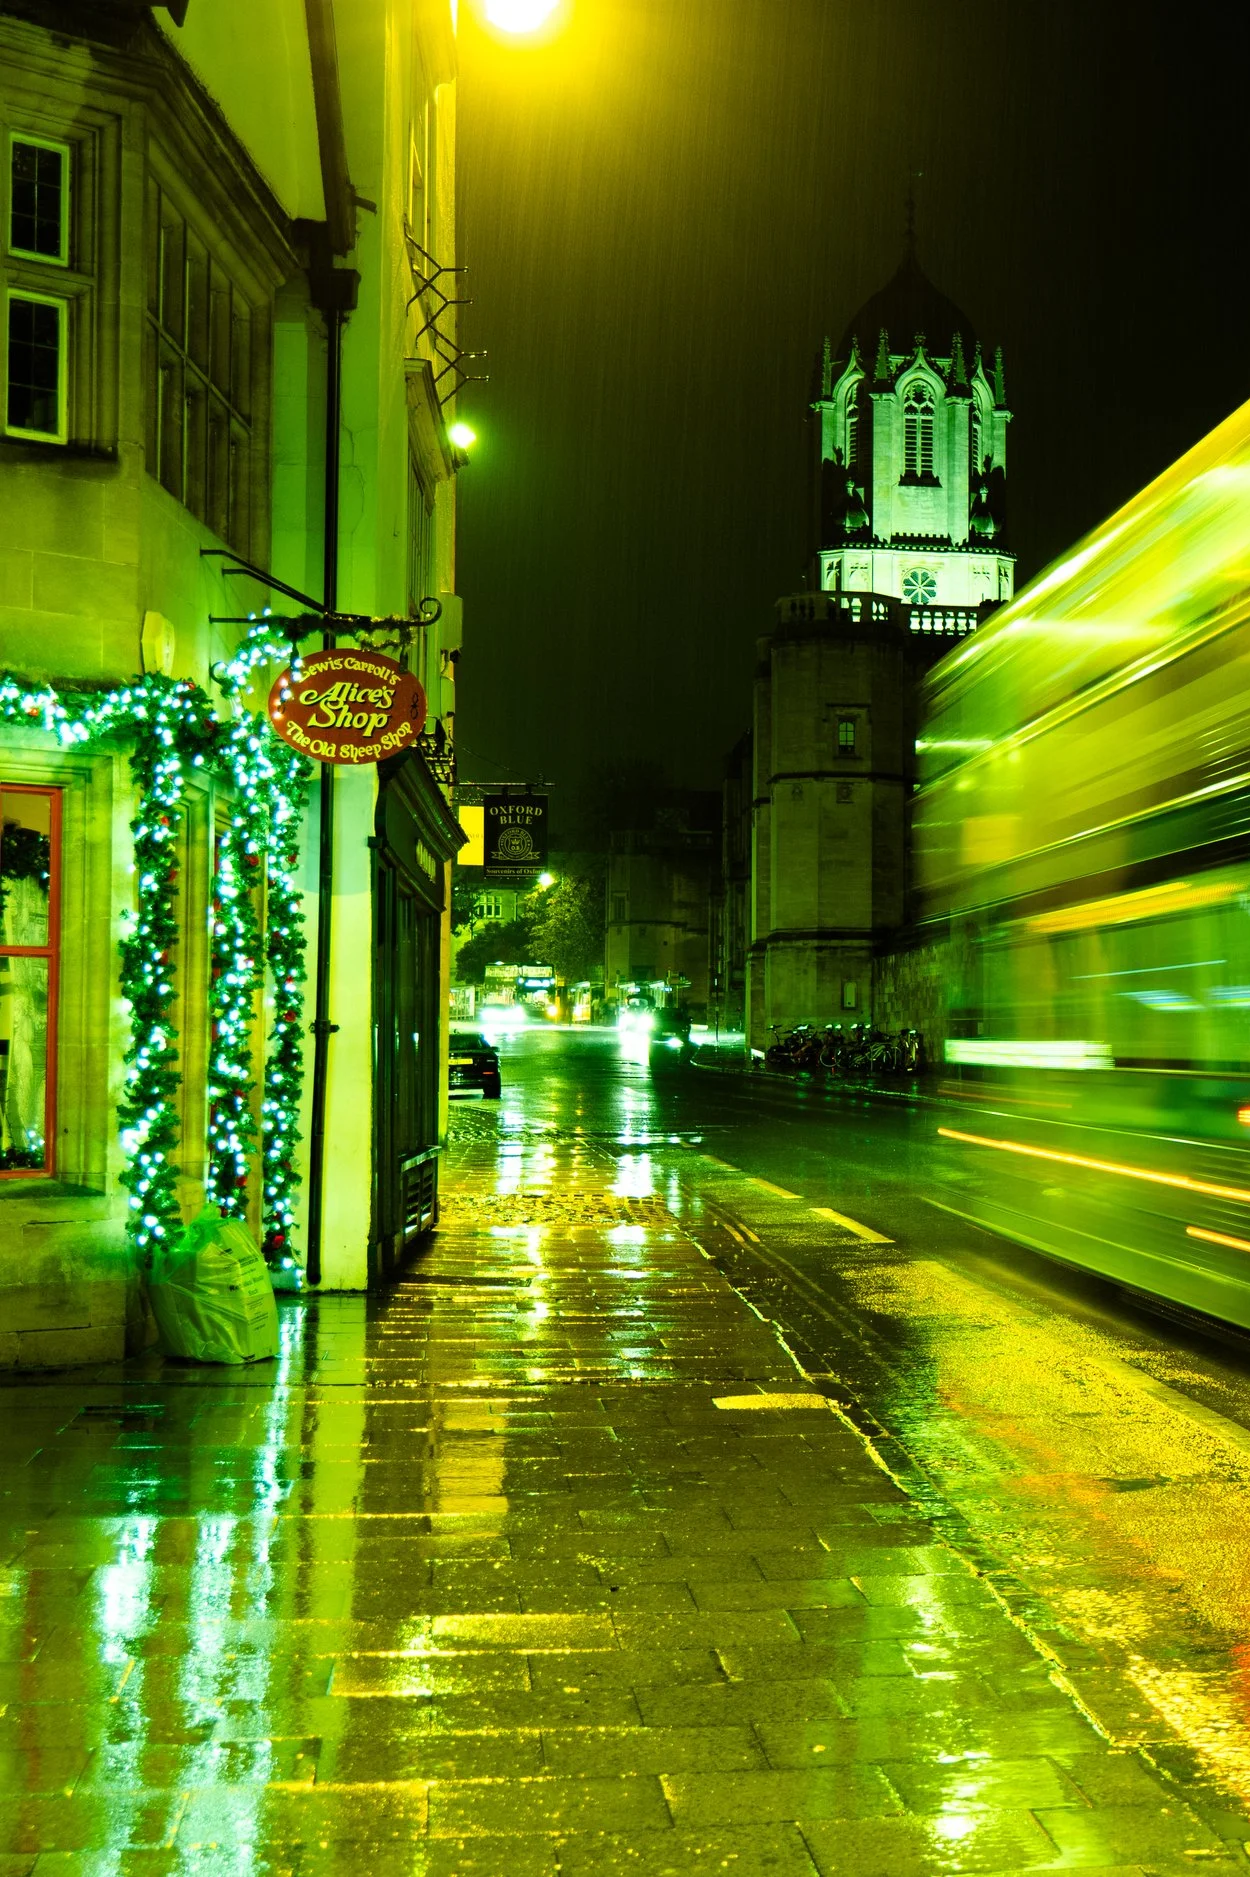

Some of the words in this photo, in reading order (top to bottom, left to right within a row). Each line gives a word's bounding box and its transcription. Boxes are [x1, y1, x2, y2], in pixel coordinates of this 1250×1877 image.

[343, 657, 402, 686] Carroll's
[299, 681, 395, 709] Alice's
[307, 698, 390, 737] Shop
[286, 720, 311, 747] The
[310, 739, 336, 758] Old
[339, 744, 382, 763] Sheep
[380, 721, 413, 750] Shop
[489, 805, 543, 817] OXFORD
[499, 815, 533, 825] BLUE
